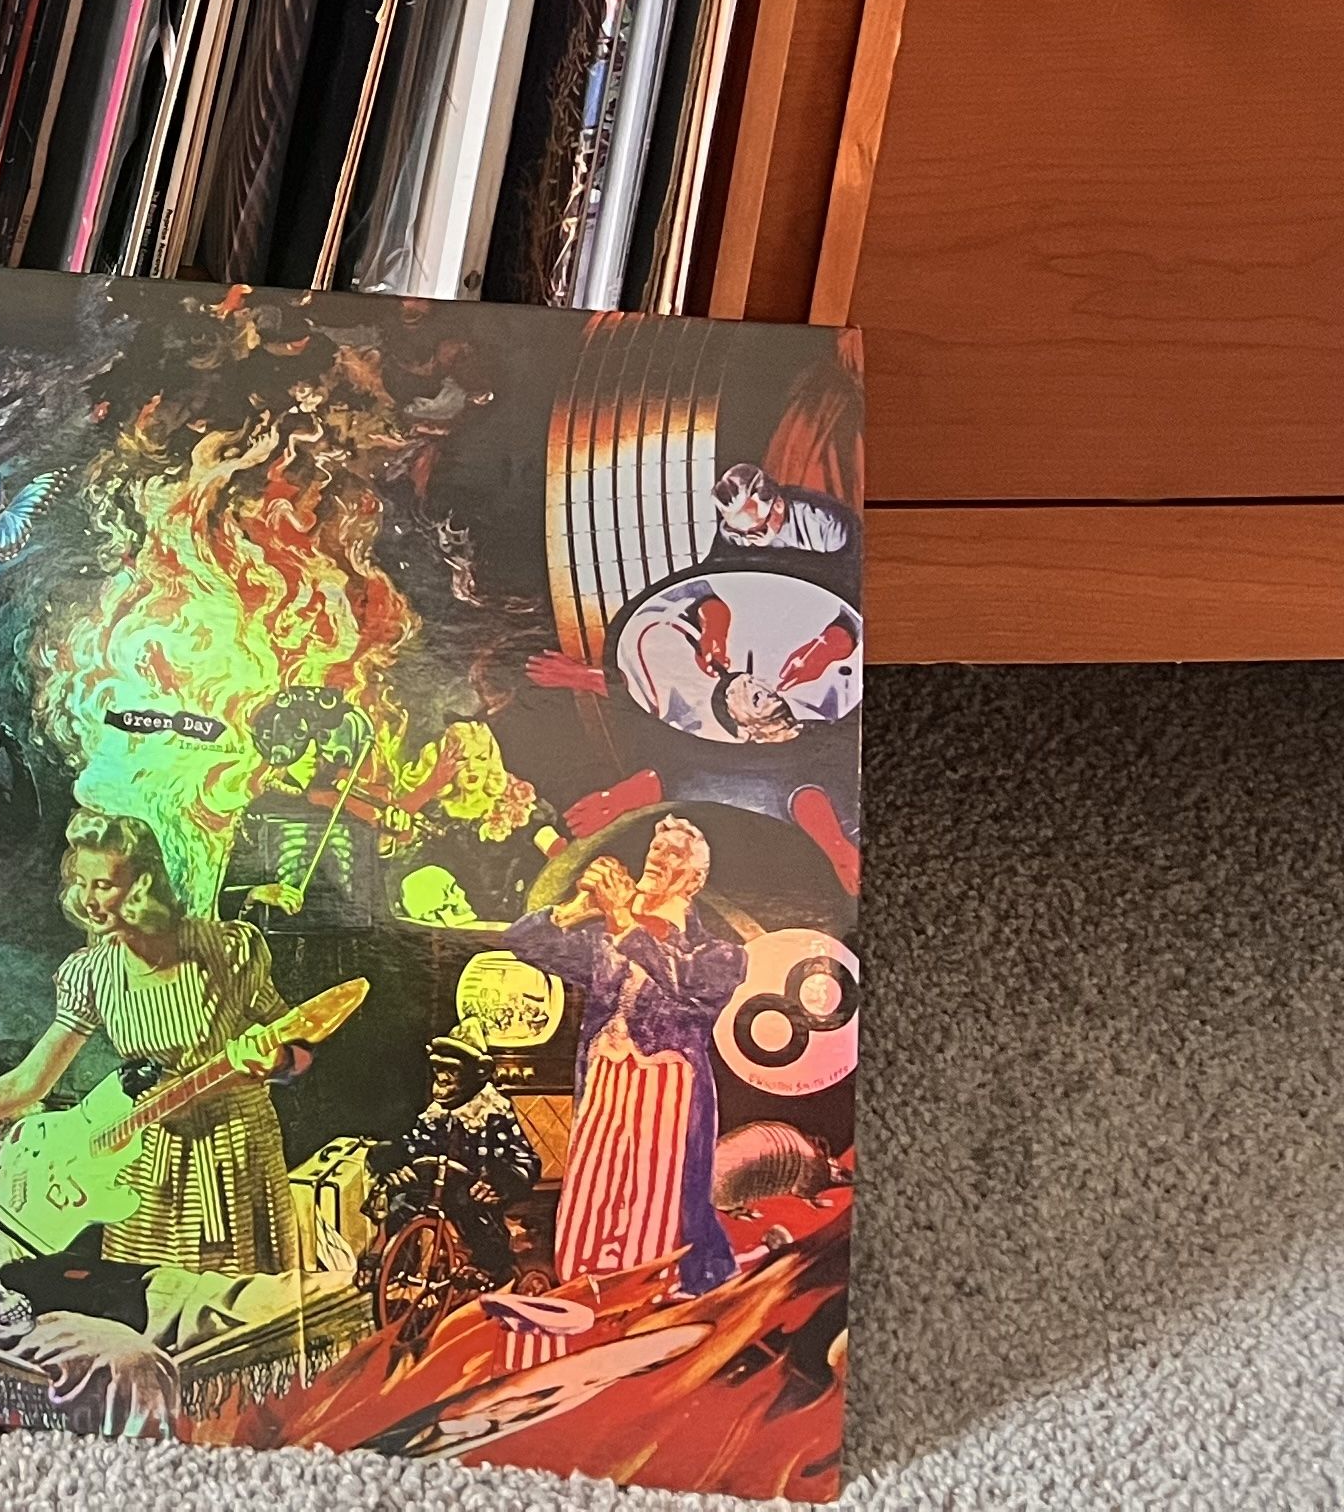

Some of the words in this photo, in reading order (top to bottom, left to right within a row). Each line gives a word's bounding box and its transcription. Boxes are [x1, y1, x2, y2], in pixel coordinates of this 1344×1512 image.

[159, 208, 173, 241] Reprise
[151, 241, 165, 277] Records
[122, 712, 173, 729] Green
[183, 716, 213, 736] Day
